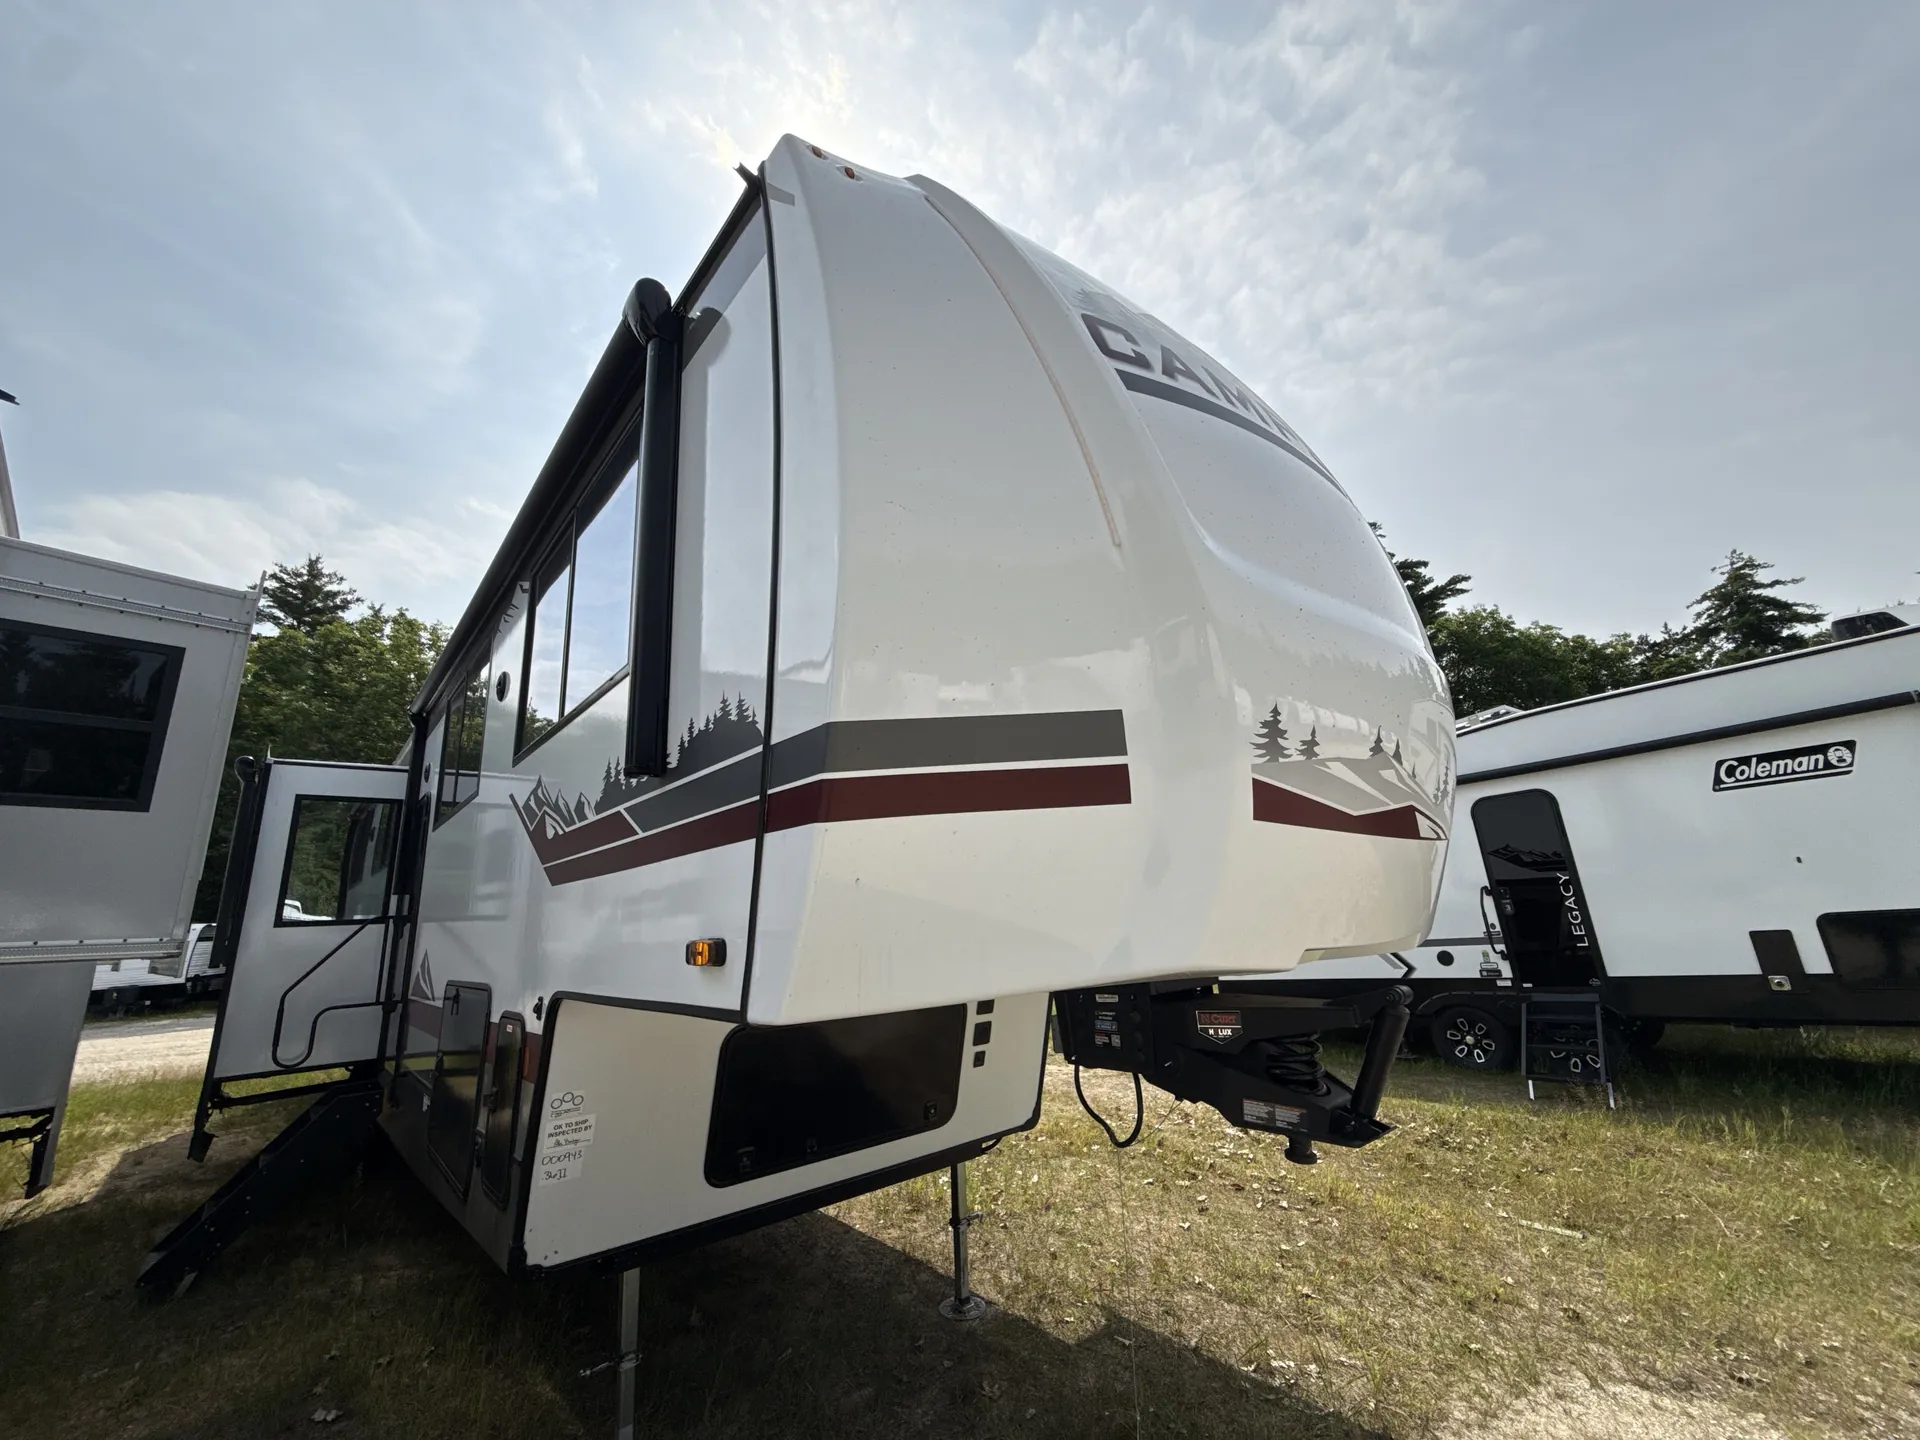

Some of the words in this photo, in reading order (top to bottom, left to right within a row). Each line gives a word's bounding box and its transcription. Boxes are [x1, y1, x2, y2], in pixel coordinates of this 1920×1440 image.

[1719, 754, 1825, 783] Coleman
[1556, 872, 1589, 947] LEGACY
[1208, 1028, 1233, 1036] HLUX
[574, 1119, 589, 1127] SHIP
[547, 1127, 583, 1138] INSPECTED
